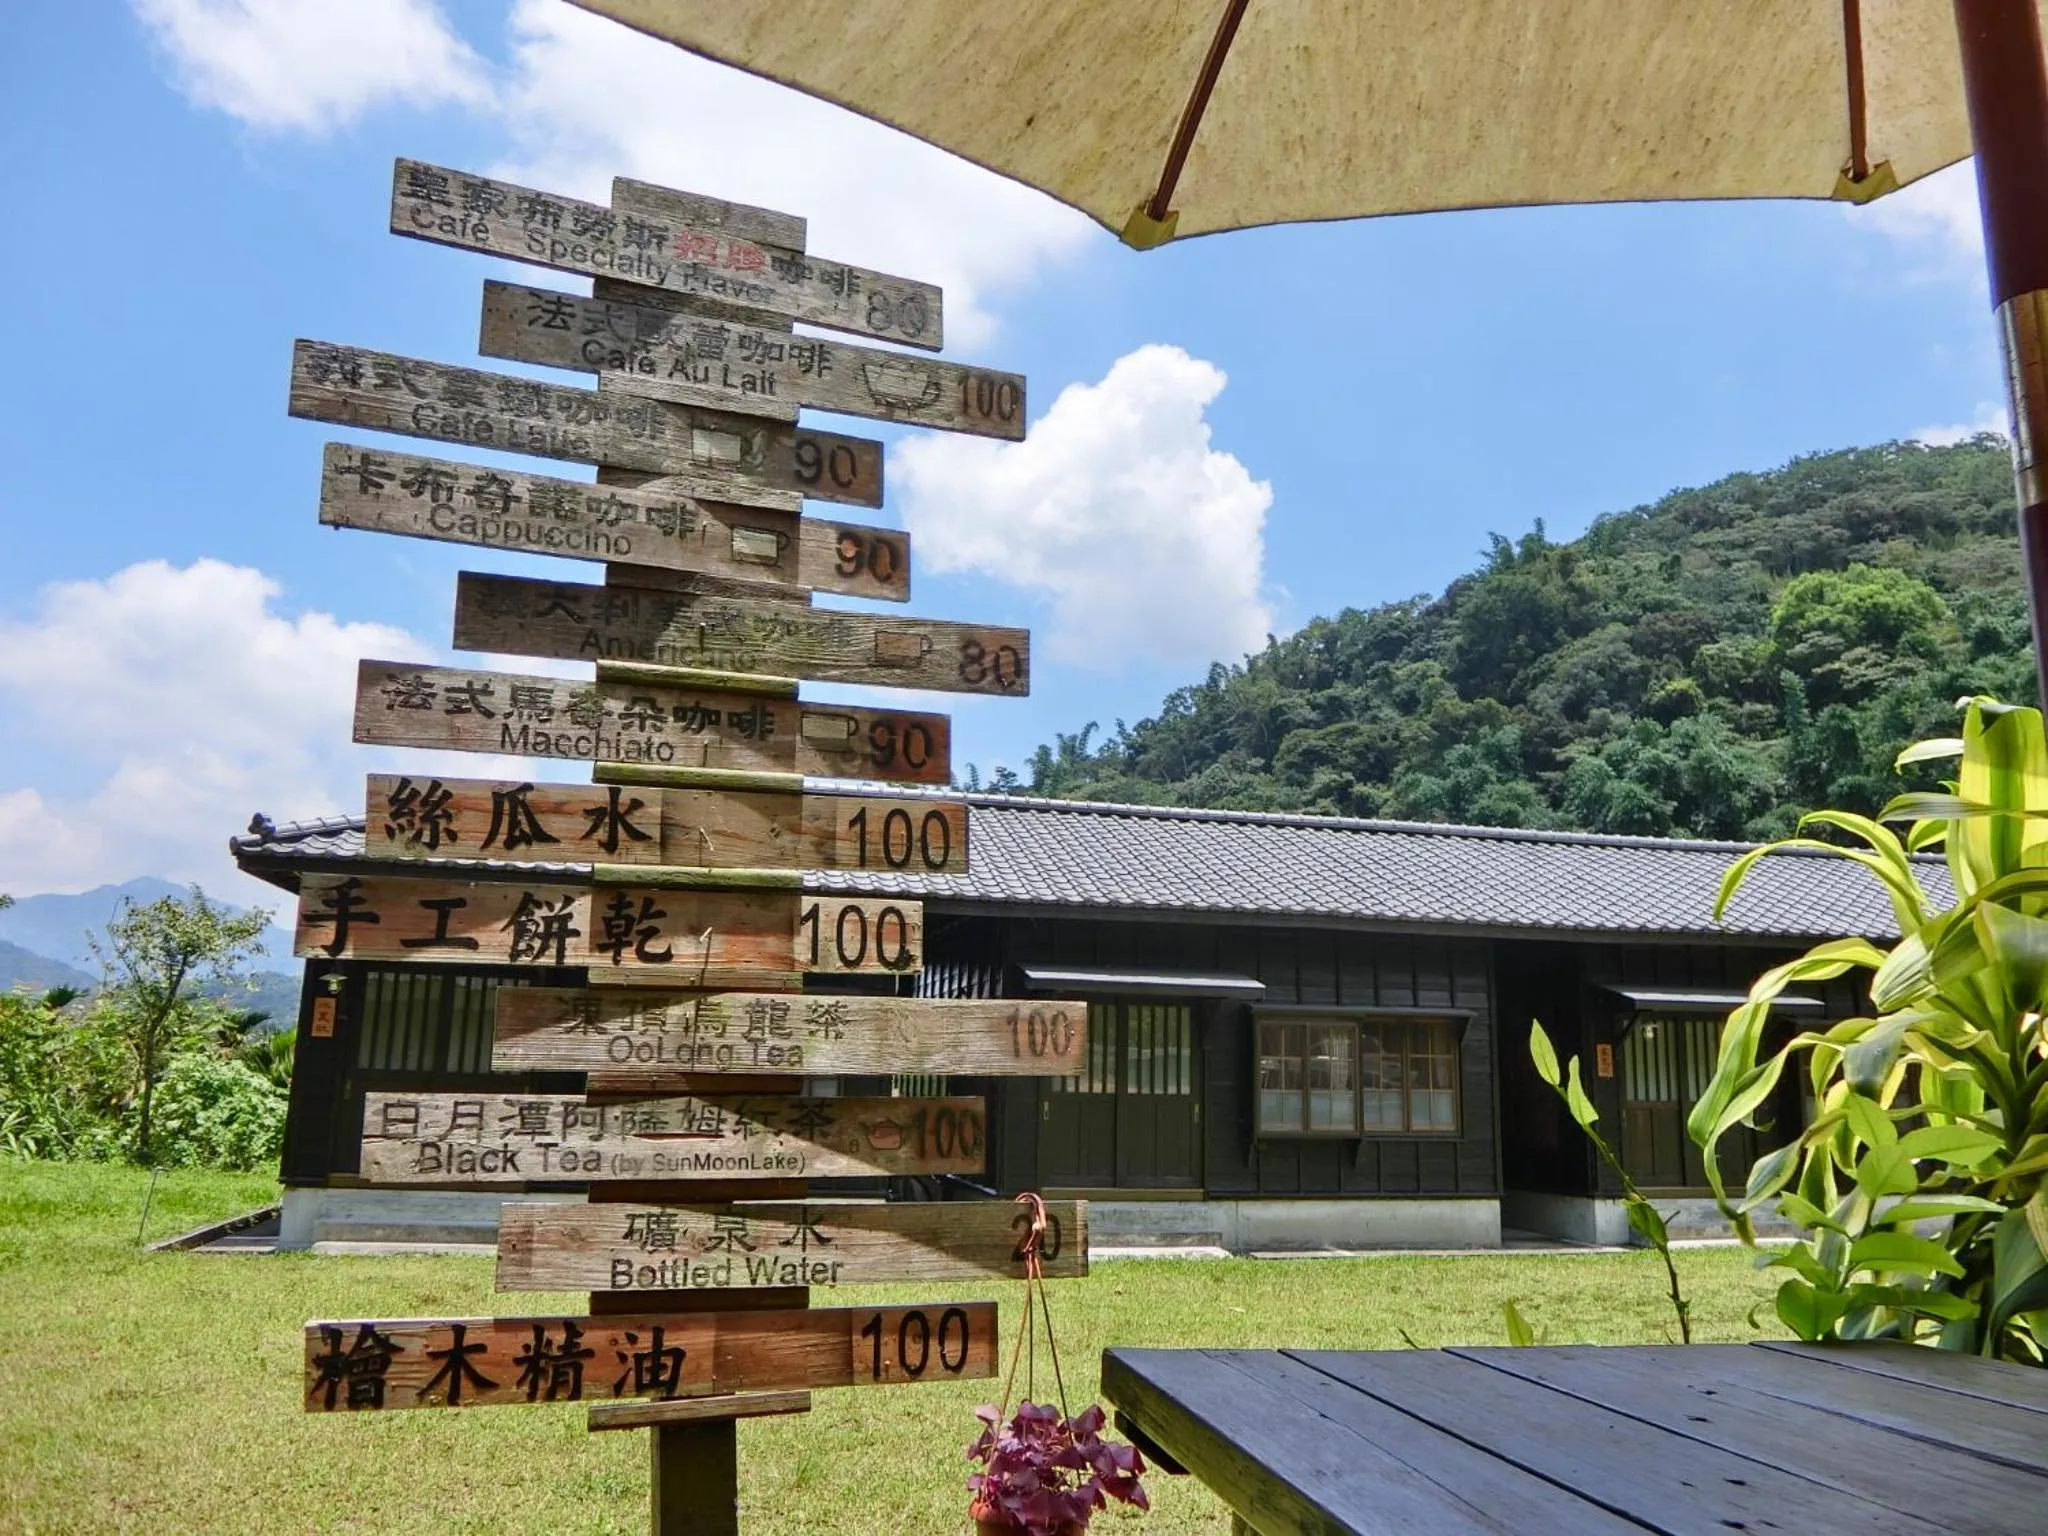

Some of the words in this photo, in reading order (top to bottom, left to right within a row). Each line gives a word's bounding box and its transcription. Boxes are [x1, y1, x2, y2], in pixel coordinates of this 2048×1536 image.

[525, 225, 671, 285] Specialty
[581, 338, 656, 375] Café
[668, 356, 709, 384] Au
[723, 364, 776, 396] Lait
[958, 371, 1020, 421] 100
[795, 438, 858, 489] 90
[429, 502, 633, 556] Cappuccino
[835, 530, 898, 582] 90
[959, 638, 1021, 688] 80
[500, 724, 675, 762] Macchiato
[869, 719, 934, 769] 90
[384, 776, 649, 853] 絲瓜水
[849, 805, 951, 870] 100
[302, 875, 675, 966] 手工餅乾
[800, 903, 914, 969] 100
[749, 1037, 804, 1068] Tea
[1006, 1007, 1071, 1057] 100
[418, 1141, 520, 1175] Black
[534, 1141, 601, 1174] Tea
[651, 1152, 806, 1174] SunMoonLake)
[912, 1107, 982, 1160] 100
[625, 1208, 834, 1254] 礦泉水
[1011, 1213, 1061, 1262] 20
[610, 1256, 732, 1290] Bottled
[746, 1257, 844, 1287] Water
[309, 1321, 686, 1409] 檜木精油
[861, 1306, 970, 1382] 100
